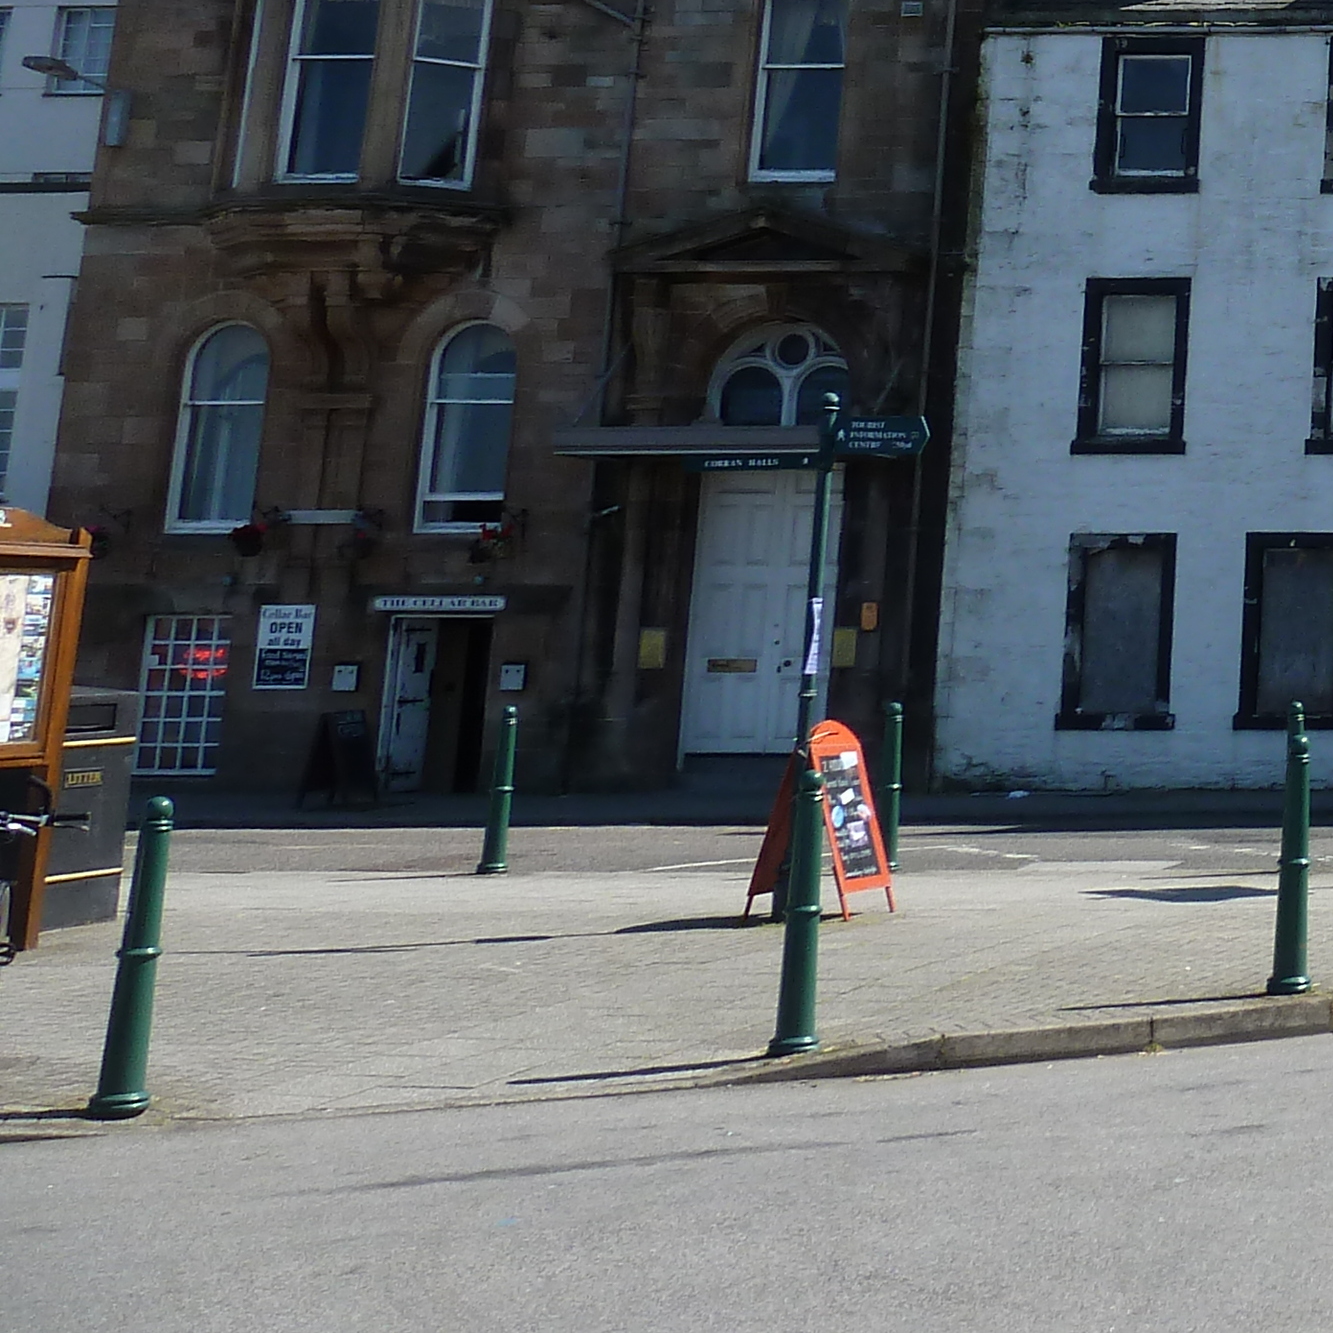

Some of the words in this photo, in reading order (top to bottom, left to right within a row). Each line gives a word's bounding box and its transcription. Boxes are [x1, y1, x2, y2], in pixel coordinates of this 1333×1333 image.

[851, 421, 885, 429] TOURIST
[849, 431, 907, 439] INFORMATION
[848, 441, 883, 449] CENTRE
[748, 458, 779, 467] HALLS
[382, 599, 406, 607] THE
[413, 598, 468, 607] CELLAR
[471, 598, 498, 607] BAR
[262, 608, 292, 619] Cellar
[295, 608, 312, 619] Bar
[270, 621, 303, 634] OPEN
[267, 636, 281, 646] all
[283, 636, 302, 648] day
[68, 772, 102, 785] LITTER
